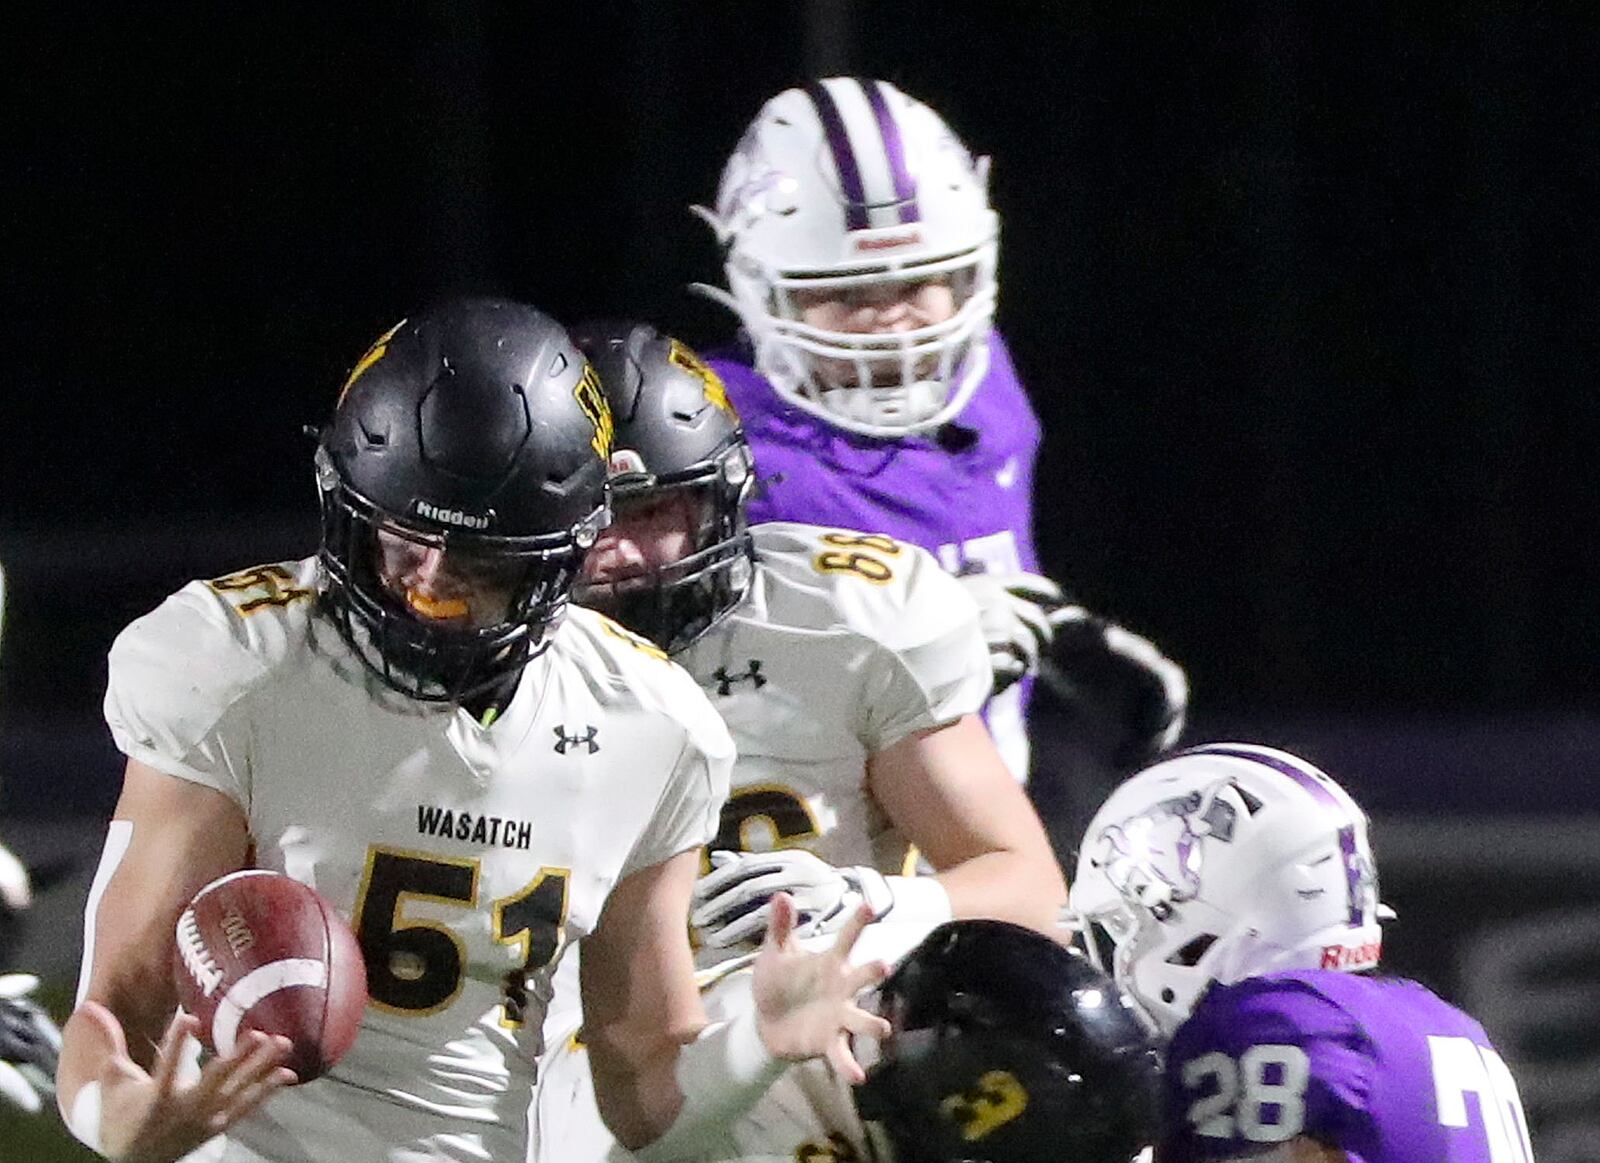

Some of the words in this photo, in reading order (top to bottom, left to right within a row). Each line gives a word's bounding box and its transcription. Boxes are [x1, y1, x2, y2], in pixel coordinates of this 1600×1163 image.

[417, 804, 532, 850] WASATCH
[351, 843, 572, 1029] 51
[1182, 1044, 1311, 1142] 28
